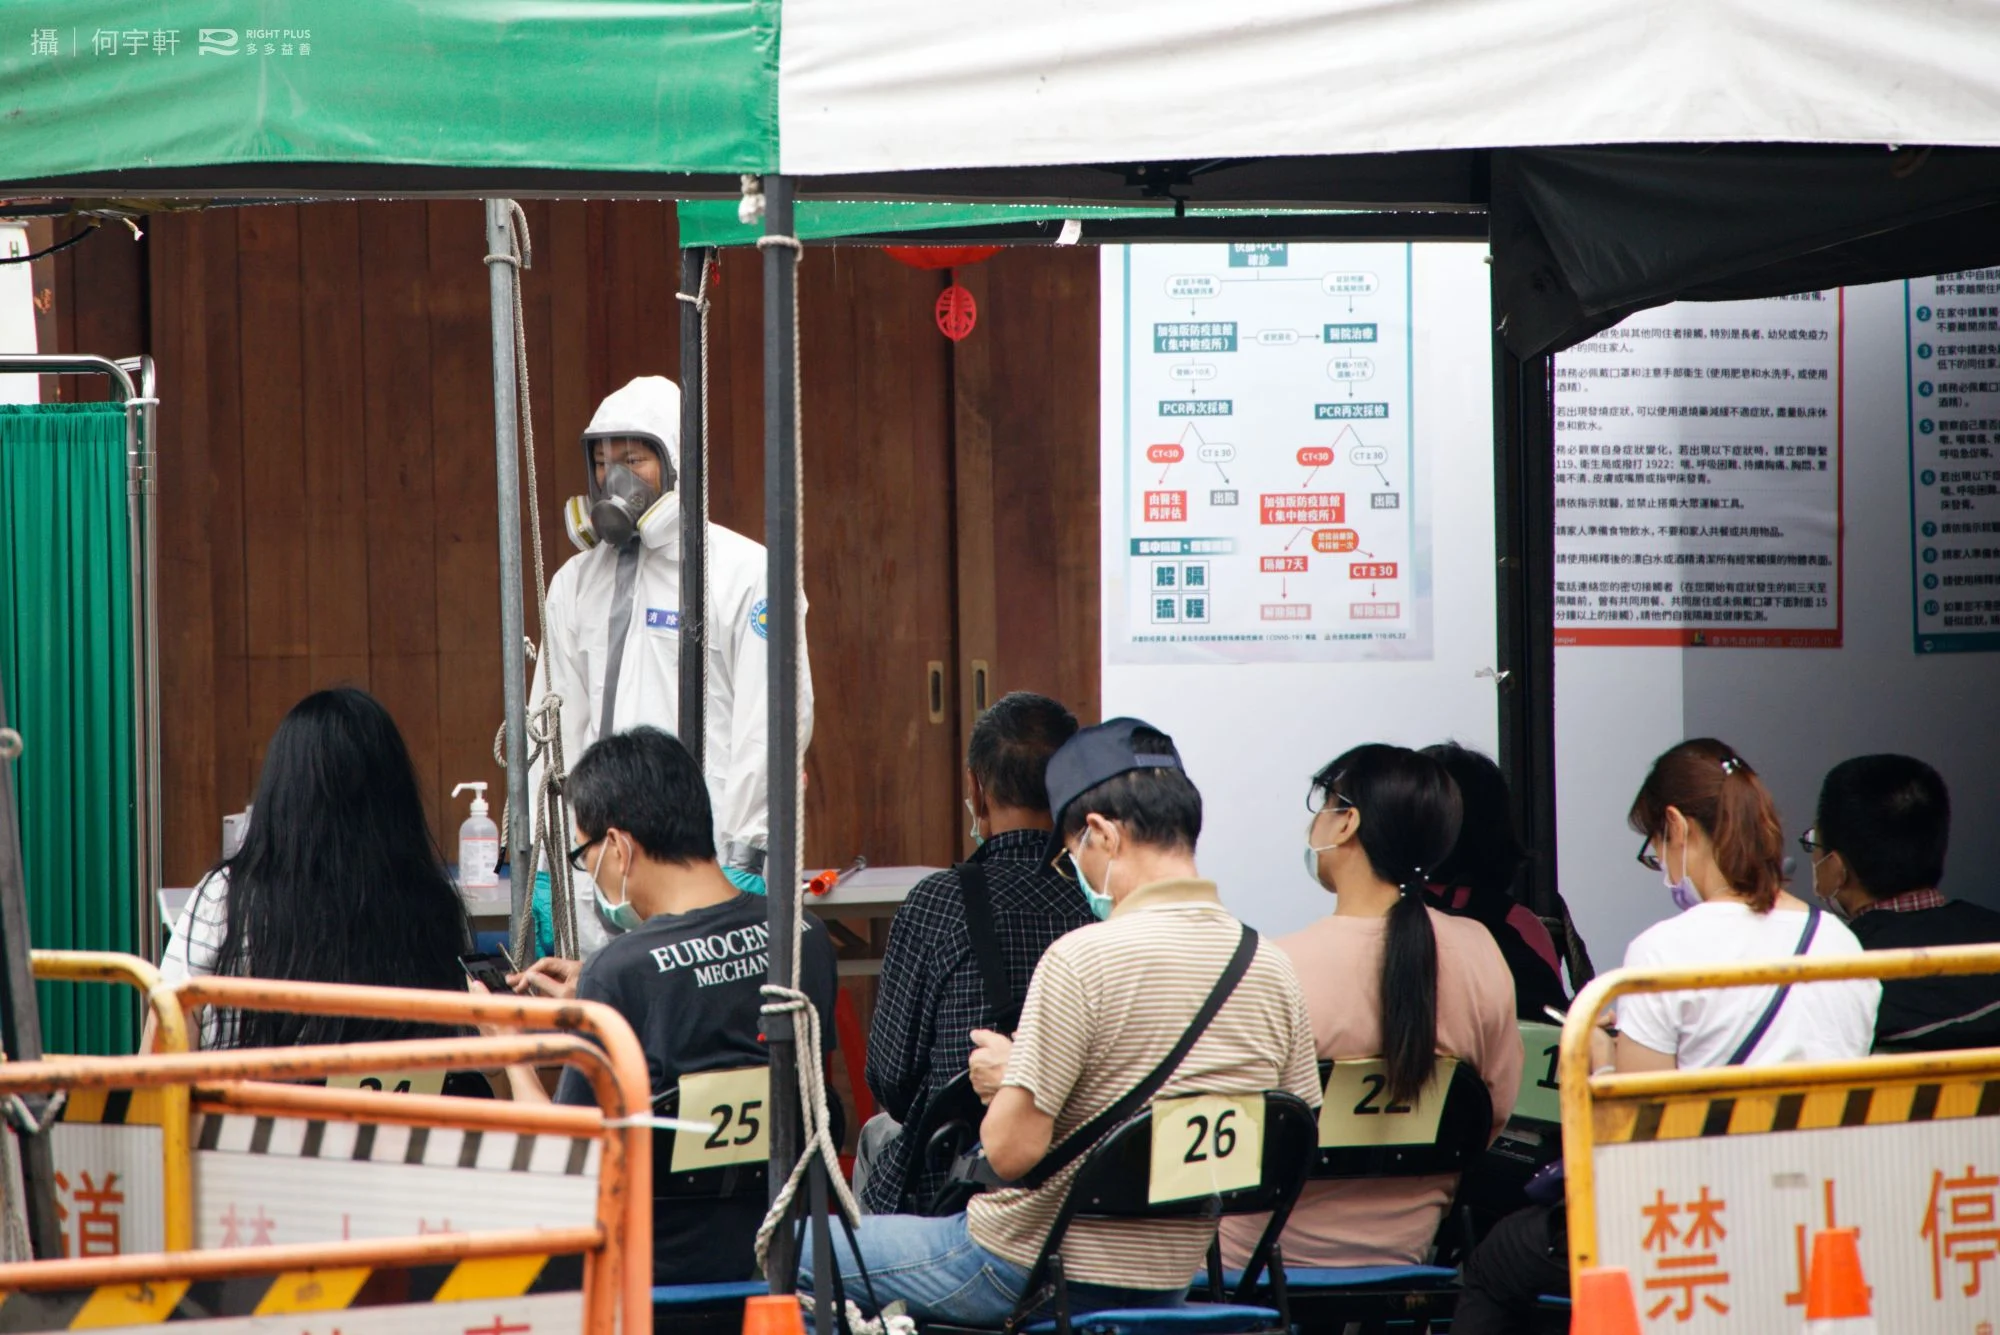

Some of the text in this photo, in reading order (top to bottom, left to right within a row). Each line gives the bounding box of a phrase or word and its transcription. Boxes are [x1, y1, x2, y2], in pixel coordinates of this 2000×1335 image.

[1938, 358, 2000, 370] 低下的同住家
[1163, 401, 1229, 414] PCR再次採檢
[1319, 404, 1385, 417] PCR再次採檢
[648, 611, 679, 627] 消除
[650, 920, 769, 973] EUROCEN
[693, 952, 769, 988] MECHAN
[704, 1100, 762, 1150] 25
[1183, 1109, 1236, 1164] 26
